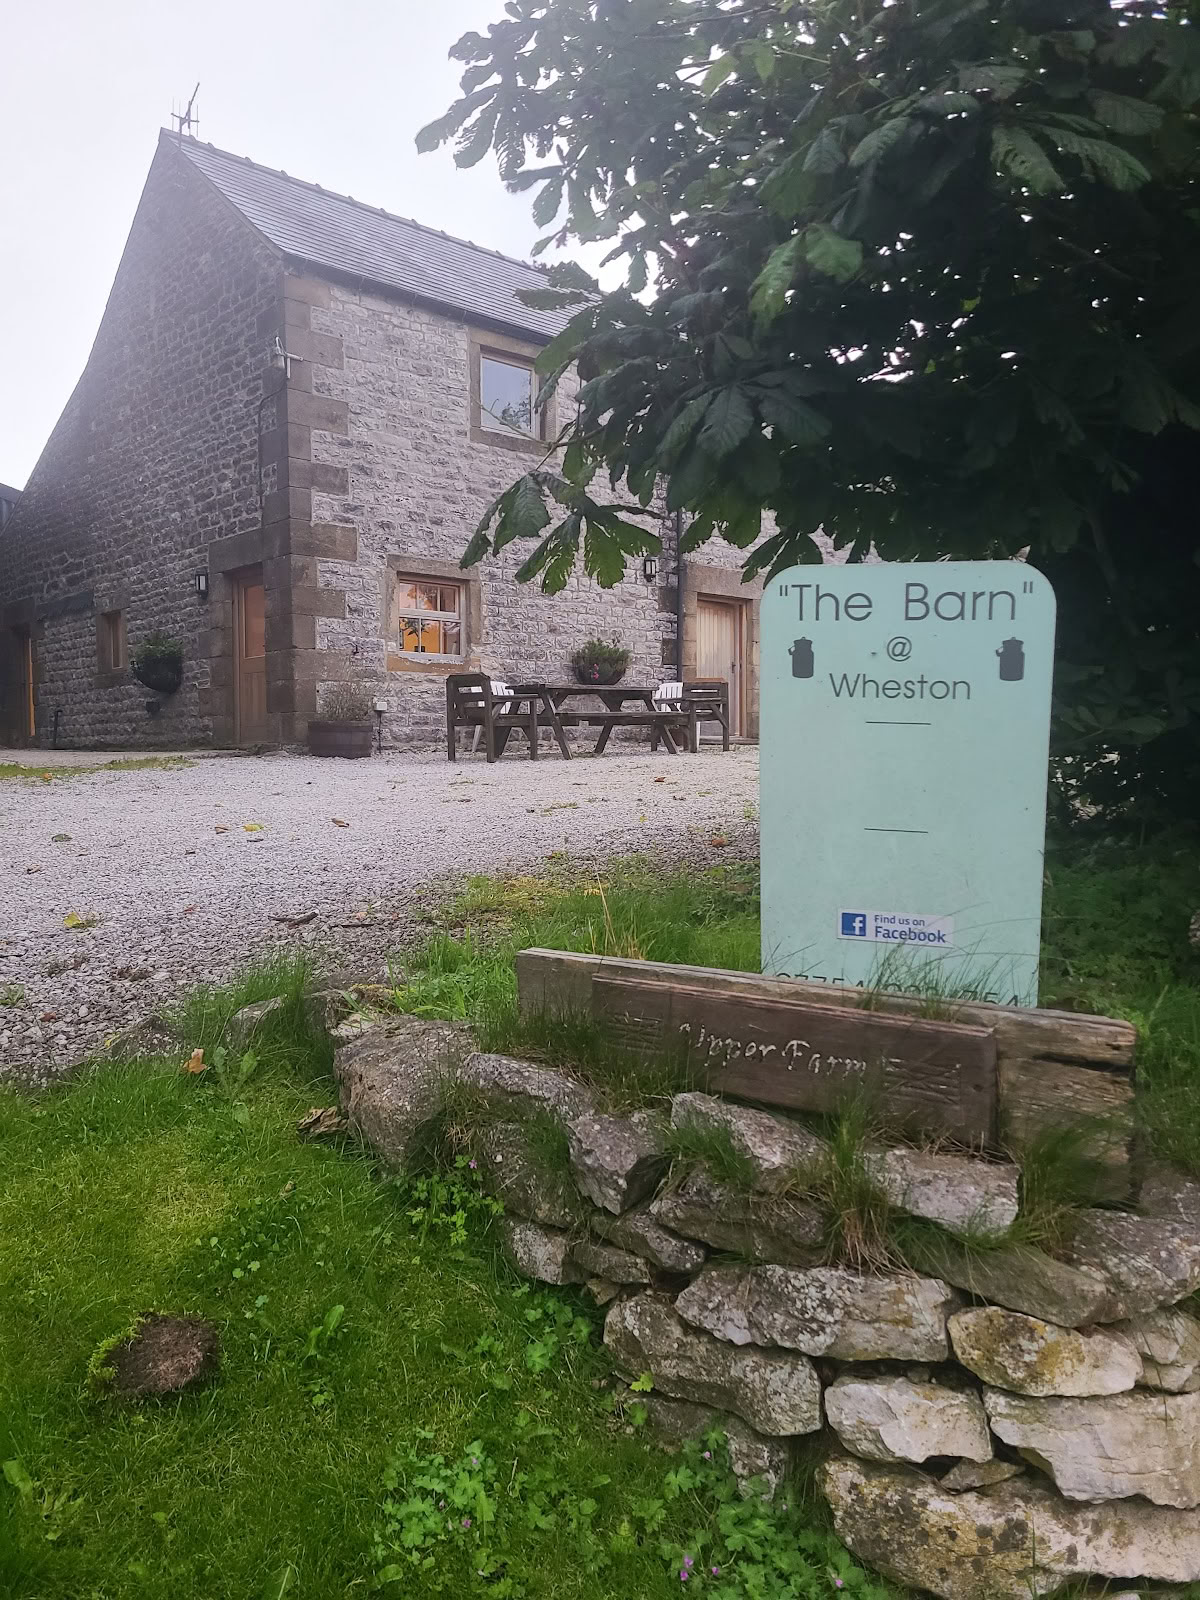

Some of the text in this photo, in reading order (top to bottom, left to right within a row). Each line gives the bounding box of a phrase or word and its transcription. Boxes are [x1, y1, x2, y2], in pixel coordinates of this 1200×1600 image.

[886, 636, 912, 662] @
[829, 673, 971, 700] Wheston
[874, 914, 896, 924] Find
[898, 917, 910, 925] us
[875, 926, 946, 943] Facebook
